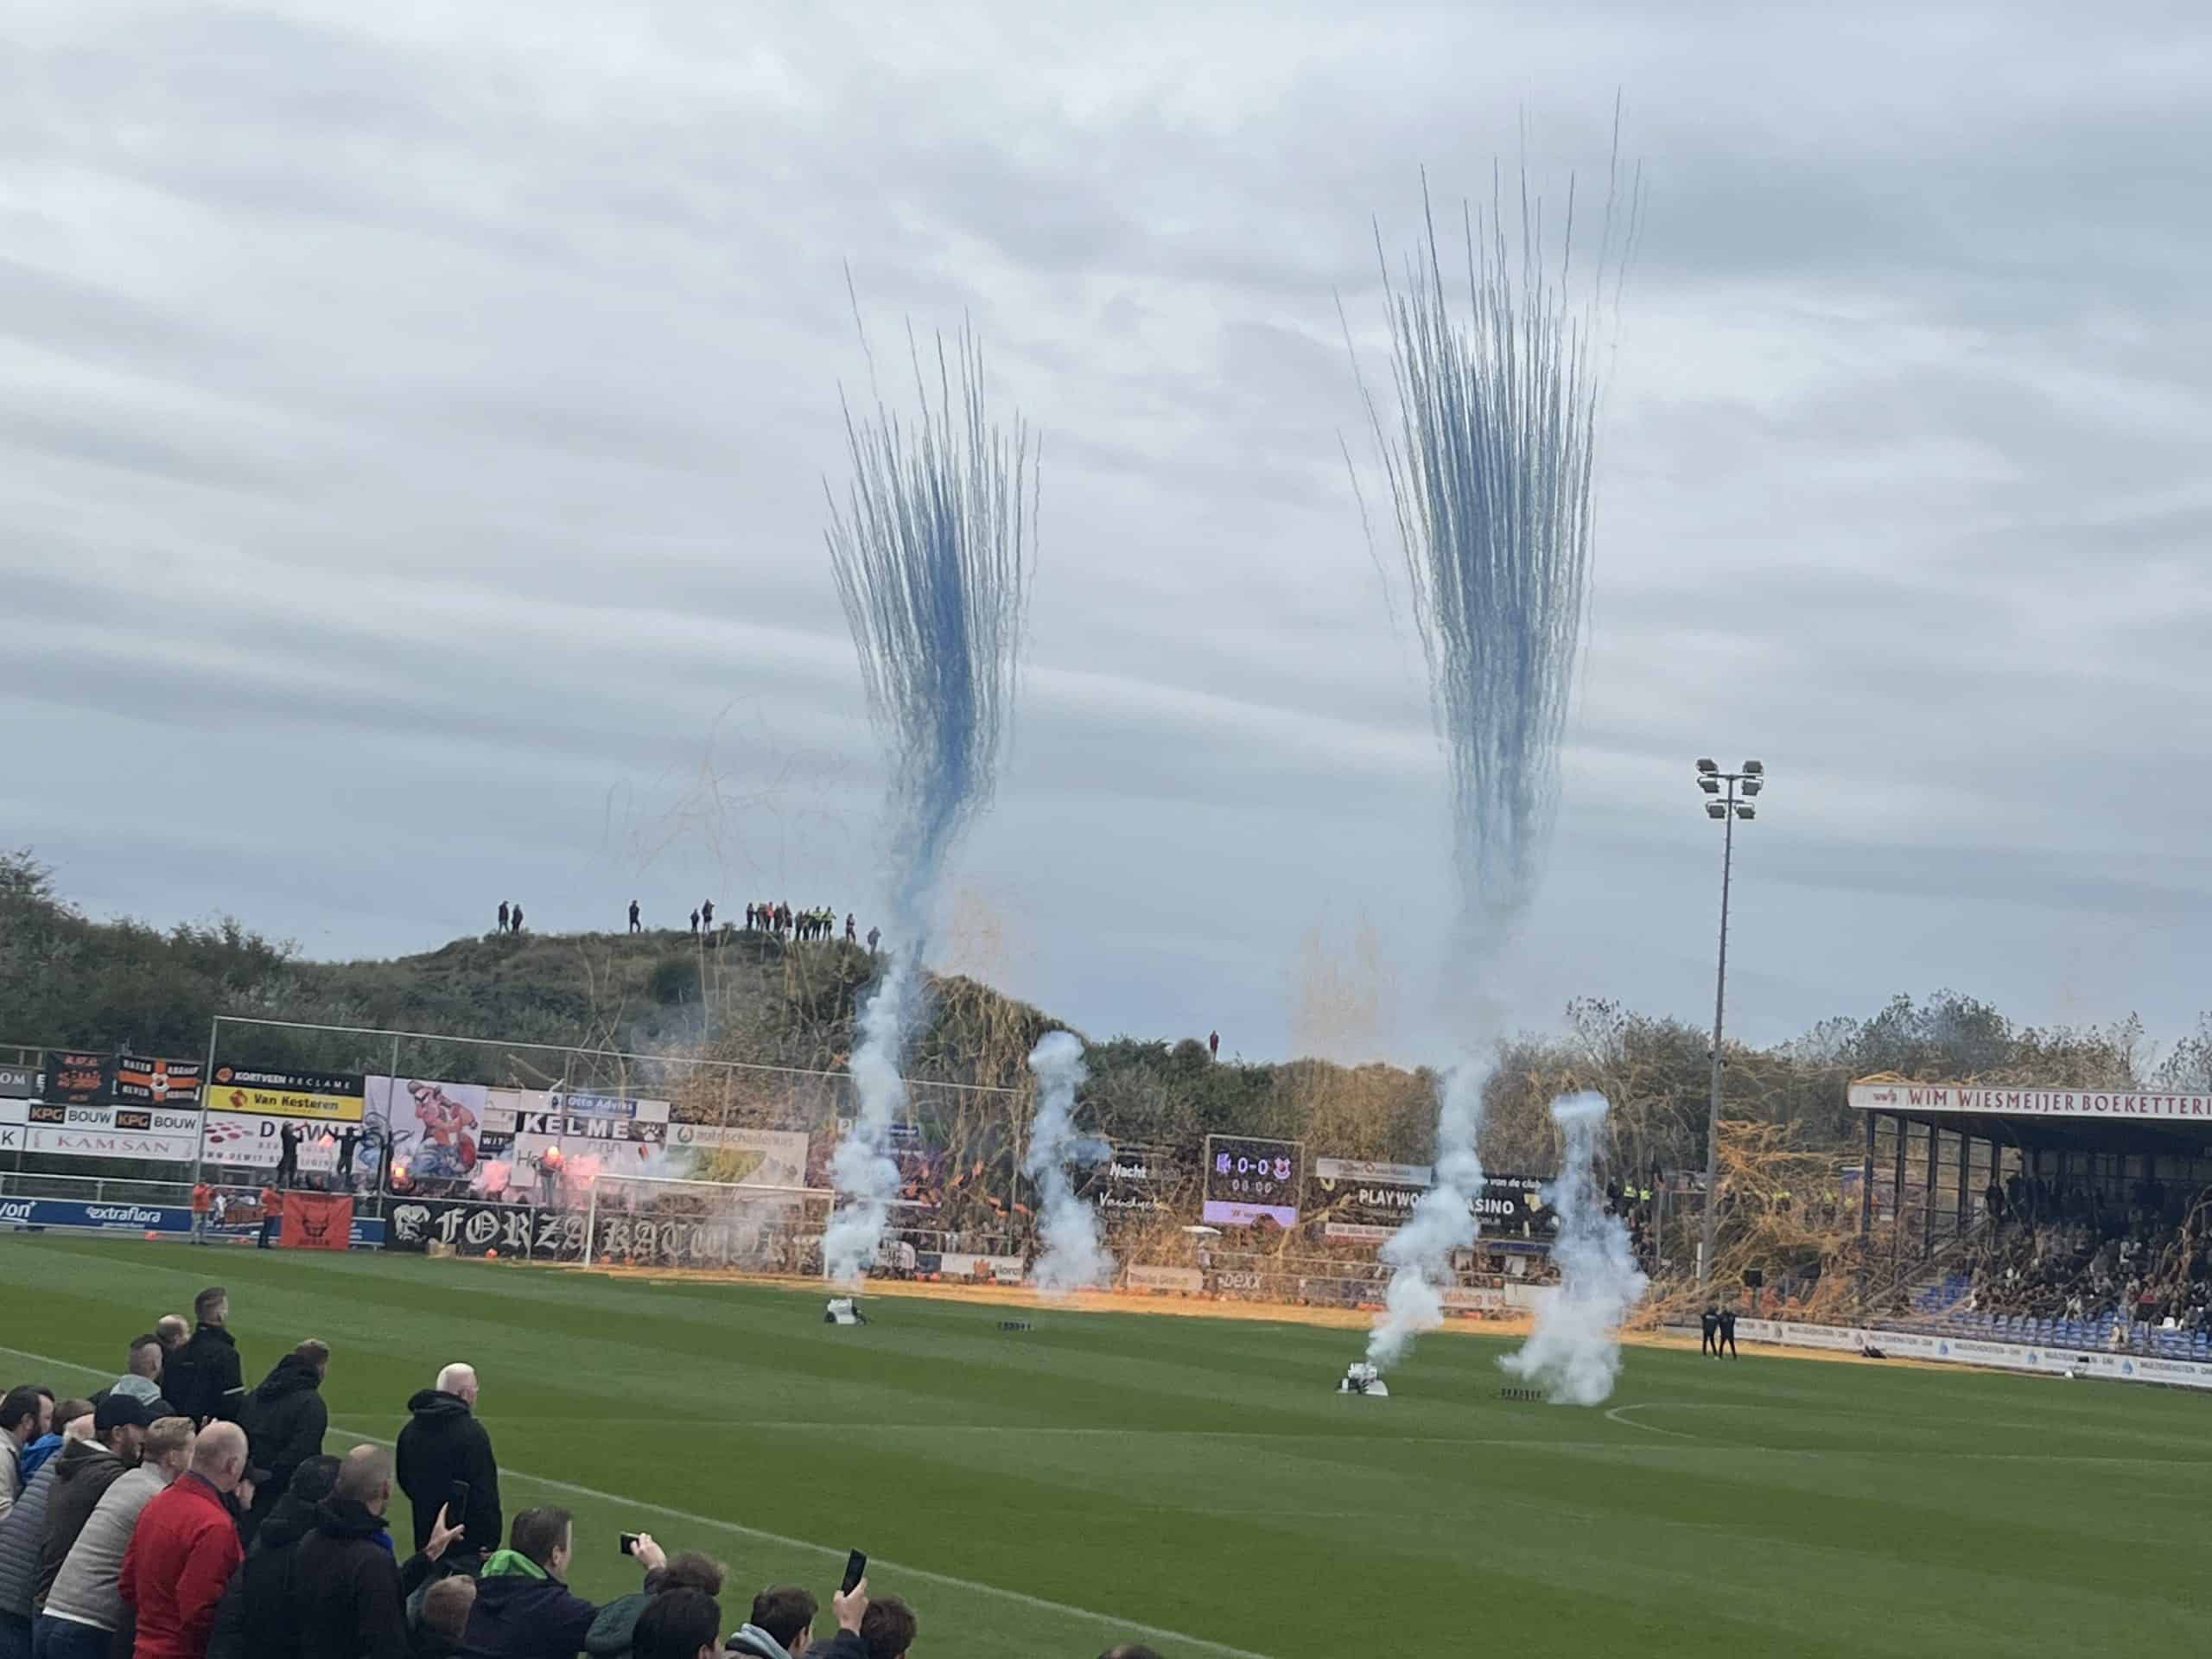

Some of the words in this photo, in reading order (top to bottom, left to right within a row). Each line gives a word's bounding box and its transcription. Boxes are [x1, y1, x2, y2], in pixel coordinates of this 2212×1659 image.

[234, 1071, 286, 1084] KORTVEEN
[288, 1077, 351, 1090] RECLAME
[254, 1094, 277, 1105] Van
[281, 1096, 339, 1110] Kesteren
[567, 1096, 594, 1107] Otto
[1908, 1089, 1948, 1107] WIM
[1958, 1090, 2075, 1112] WIESMEIJER
[30, 1107, 64, 1121] KPG
[68, 1110, 112, 1123] BOUW
[117, 1114, 149, 1128] KPG
[154, 1116, 197, 1129] BOUW
[523, 1112, 630, 1140] KELME
[57, 1135, 170, 1154] KAMSAN
[1491, 1179, 1507, 1187] van
[1509, 1178, 1520, 1189] de
[1522, 1179, 1541, 1190] club
[87, 1206, 162, 1223] extraflora
[434, 1208, 588, 1251] FORZA
